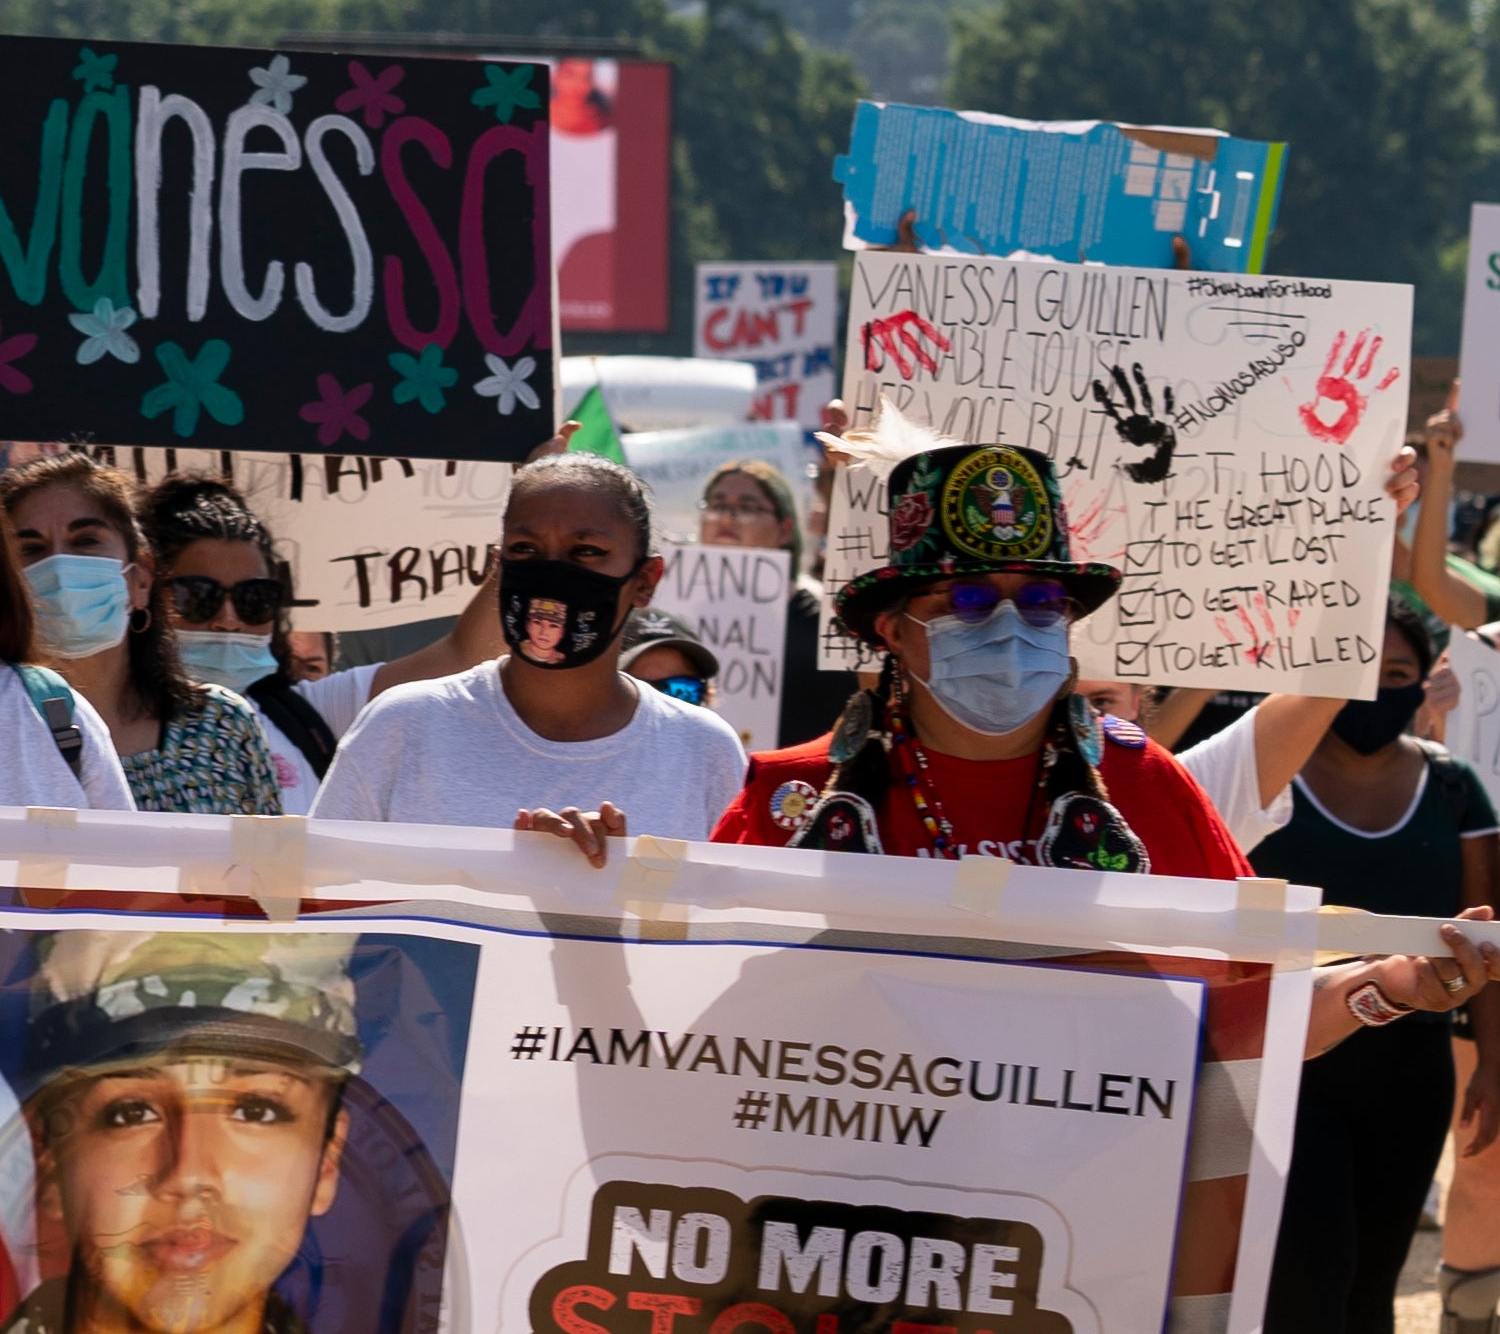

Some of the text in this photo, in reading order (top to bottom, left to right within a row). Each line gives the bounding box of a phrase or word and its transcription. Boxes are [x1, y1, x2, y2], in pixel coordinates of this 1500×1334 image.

[706, 273, 740, 302] IF
[858, 262, 1018, 329] VANESSA
[1035, 269, 1169, 342] GUILLEN
[1260, 451, 1361, 495] HOOD
[1144, 496, 1385, 534] THE GREAT PLACE
[1166, 533, 1346, 569] TO GET LOST
[1153, 579, 1362, 621] TO GET RAPED
[1152, 633, 1377, 674] TO GET KILLED
[510, 1024, 1177, 1121] #IAMVANESSAGUILLEN
[734, 1089, 947, 1149] #MMIW
[608, 1205, 1021, 1316] NO MORE
